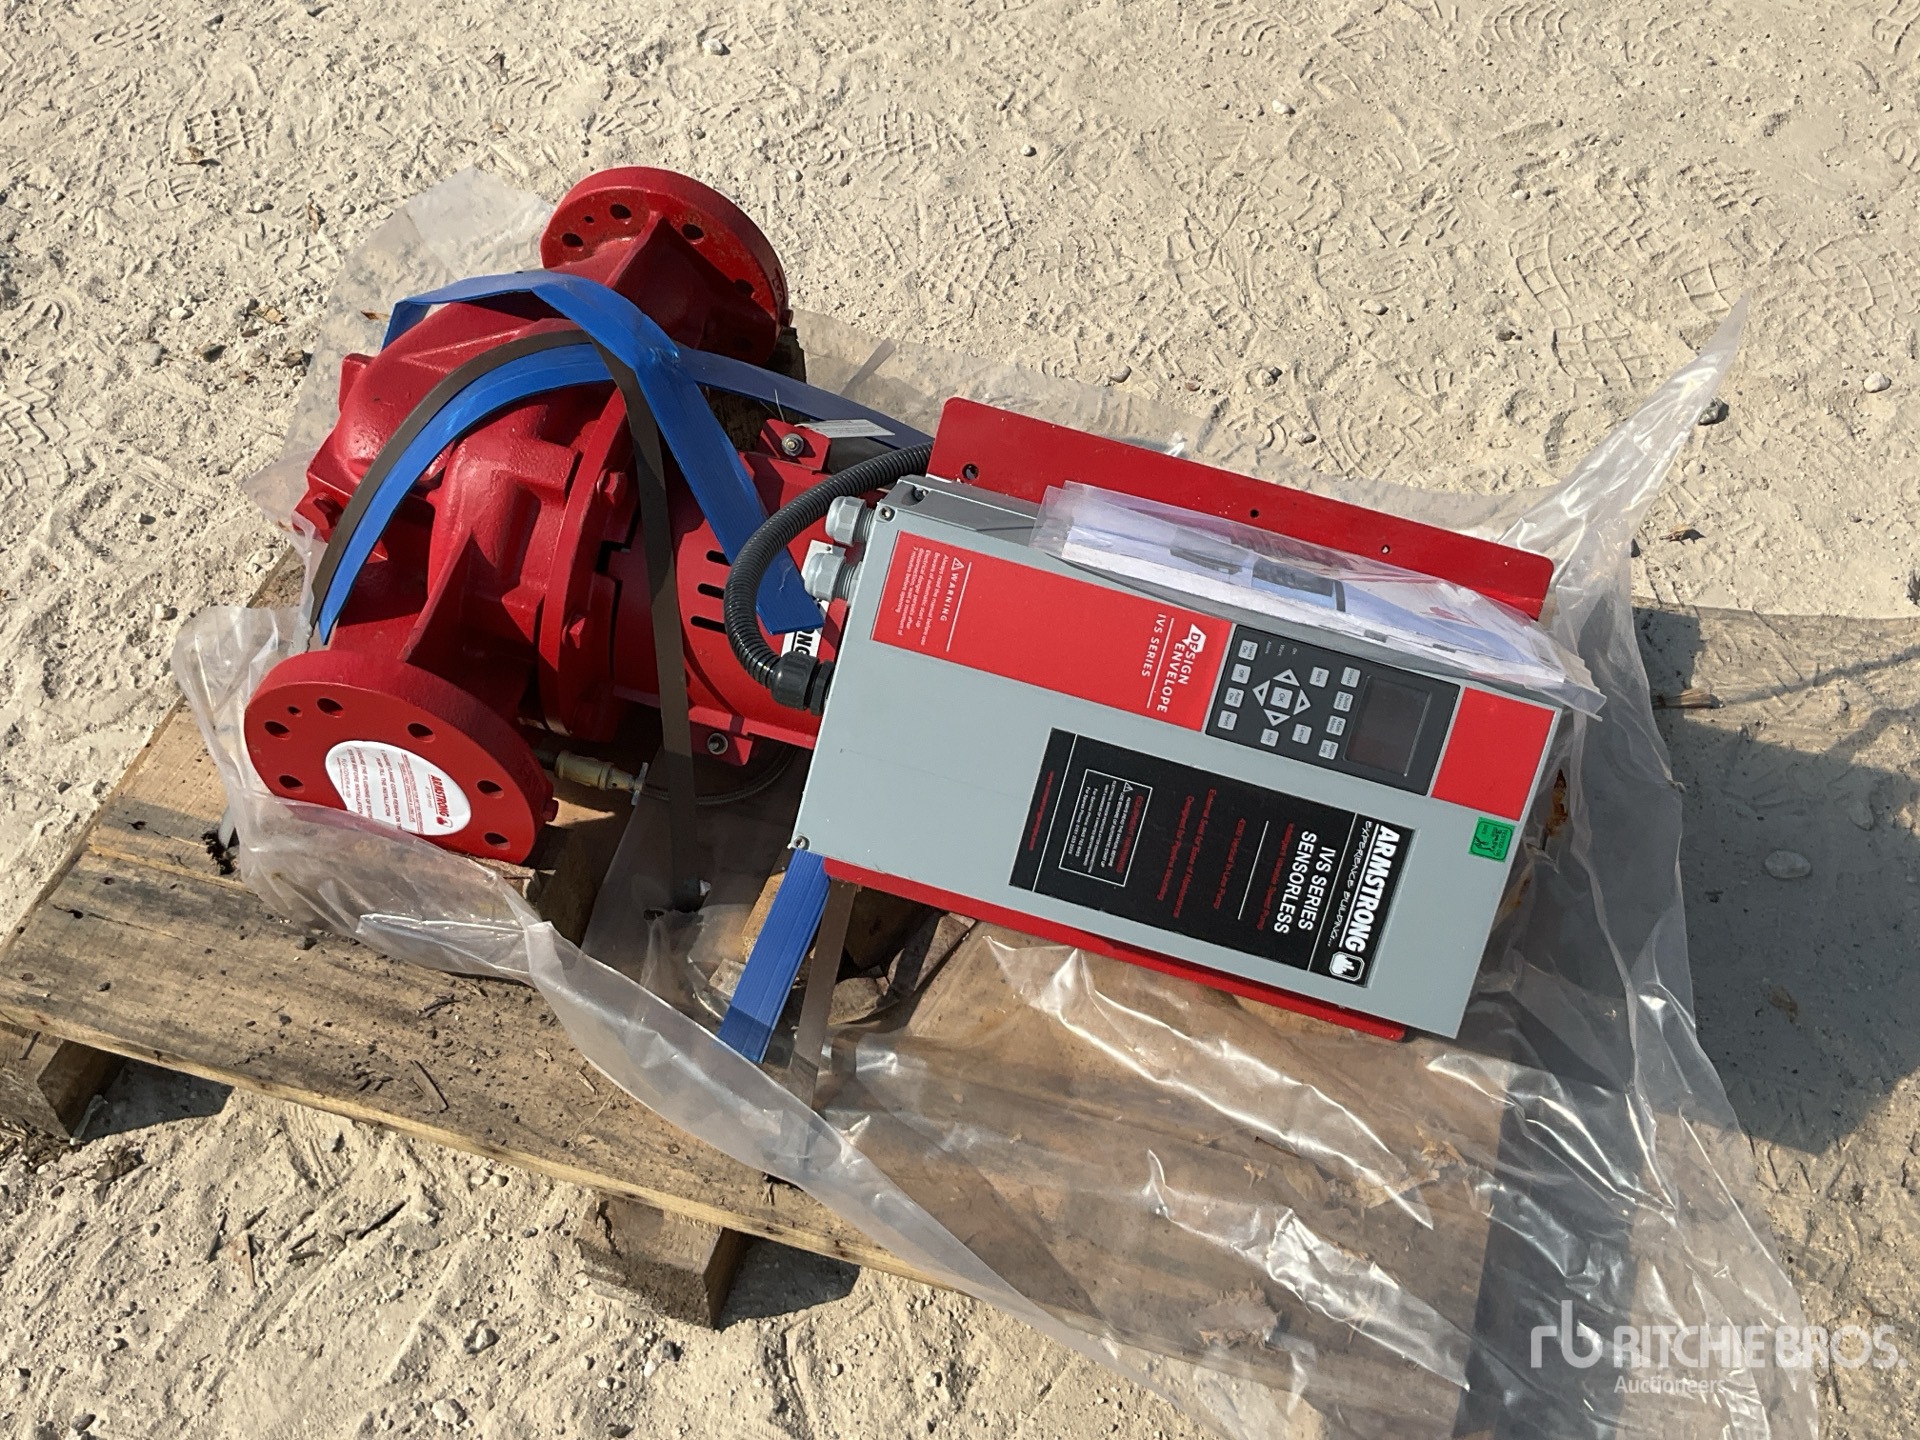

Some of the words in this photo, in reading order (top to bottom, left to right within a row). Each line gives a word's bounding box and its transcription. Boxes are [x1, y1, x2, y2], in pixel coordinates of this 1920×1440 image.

[906, 550, 916, 572] minutes
[919, 549, 931, 574] Electrical
[929, 551, 940, 572] Beware
[938, 554, 949, 574] Always
[901, 572, 911, 590] before
[913, 574, 924, 593] danger
[935, 575, 943, 588] read
[894, 590, 905, 612] opening
[920, 579, 933, 606] automatic
[932, 588, 940, 597] the
[939, 571, 958, 622] WARNING
[908, 594, 918, 615] persists
[917, 606, 925, 619] start
[927, 597, 937, 617] manual
[898, 604, 909, 628] minimum
[905, 616, 913, 629] after
[922, 618, 931, 635] before
[1152, 613, 1166, 634] IVS
[1140, 636, 1159, 677] SERIES
[1177, 631, 1201, 685] DESIGN
[1241, 645, 1247, 653] On
[1156, 642, 1185, 713] ENVELOPE
[1345, 669, 1354, 684] Status
[1228, 692, 1234, 700] On
[1277, 692, 1285, 702] OK
[1335, 693, 1343, 708] Menu
[1328, 717, 1336, 731] Menu
[382, 786, 390, 816] INSTALLATION
[430, 774, 449, 817] ARMSTRONG
[1126, 795, 1143, 835] EQUIPMENT
[1177, 794, 1194, 829] Designed
[1105, 824, 1115, 847] AUTOMATIC
[1175, 829, 1184, 839] for
[1193, 835, 1203, 845] for
[1101, 848, 1109, 860] START
[1107, 849, 1116, 866] BEFORE
[1187, 845, 1200, 864] Ease
[1314, 846, 1336, 873] IVS
[1343, 819, 1372, 889] EXPERIENCE
[1185, 864, 1194, 873] of
[1271, 829, 1318, 935] SENSORLESS
[1342, 824, 1401, 954] ARMSTRONG
[1212, 887, 1226, 910] Pump
[1296, 873, 1327, 931] SERIES
[1256, 908, 1269, 930] Pump
